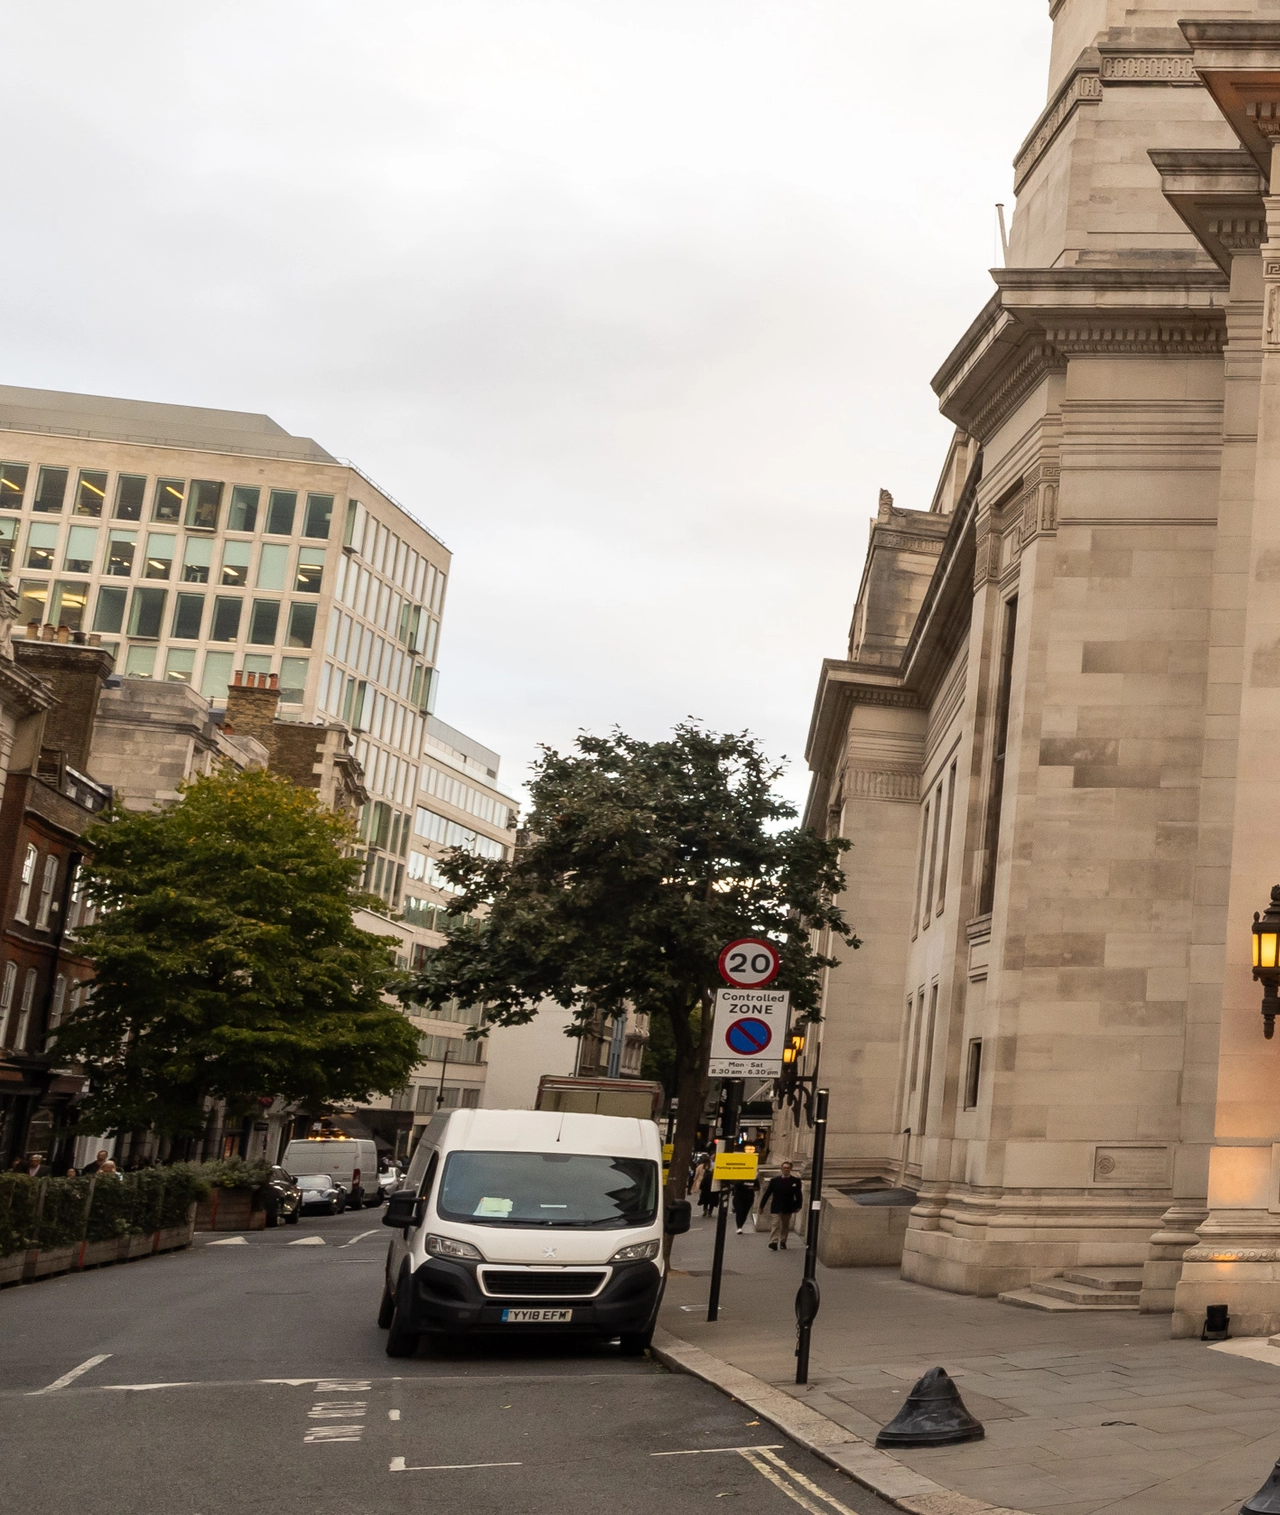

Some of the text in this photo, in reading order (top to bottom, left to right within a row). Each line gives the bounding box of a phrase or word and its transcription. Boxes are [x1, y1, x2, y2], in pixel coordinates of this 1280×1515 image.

[729, 953, 771, 974] 20
[722, 992, 785, 1003] Controlled
[729, 1004, 773, 1015] ZONE
[513, 1310, 568, 1320] YY18 EFM
